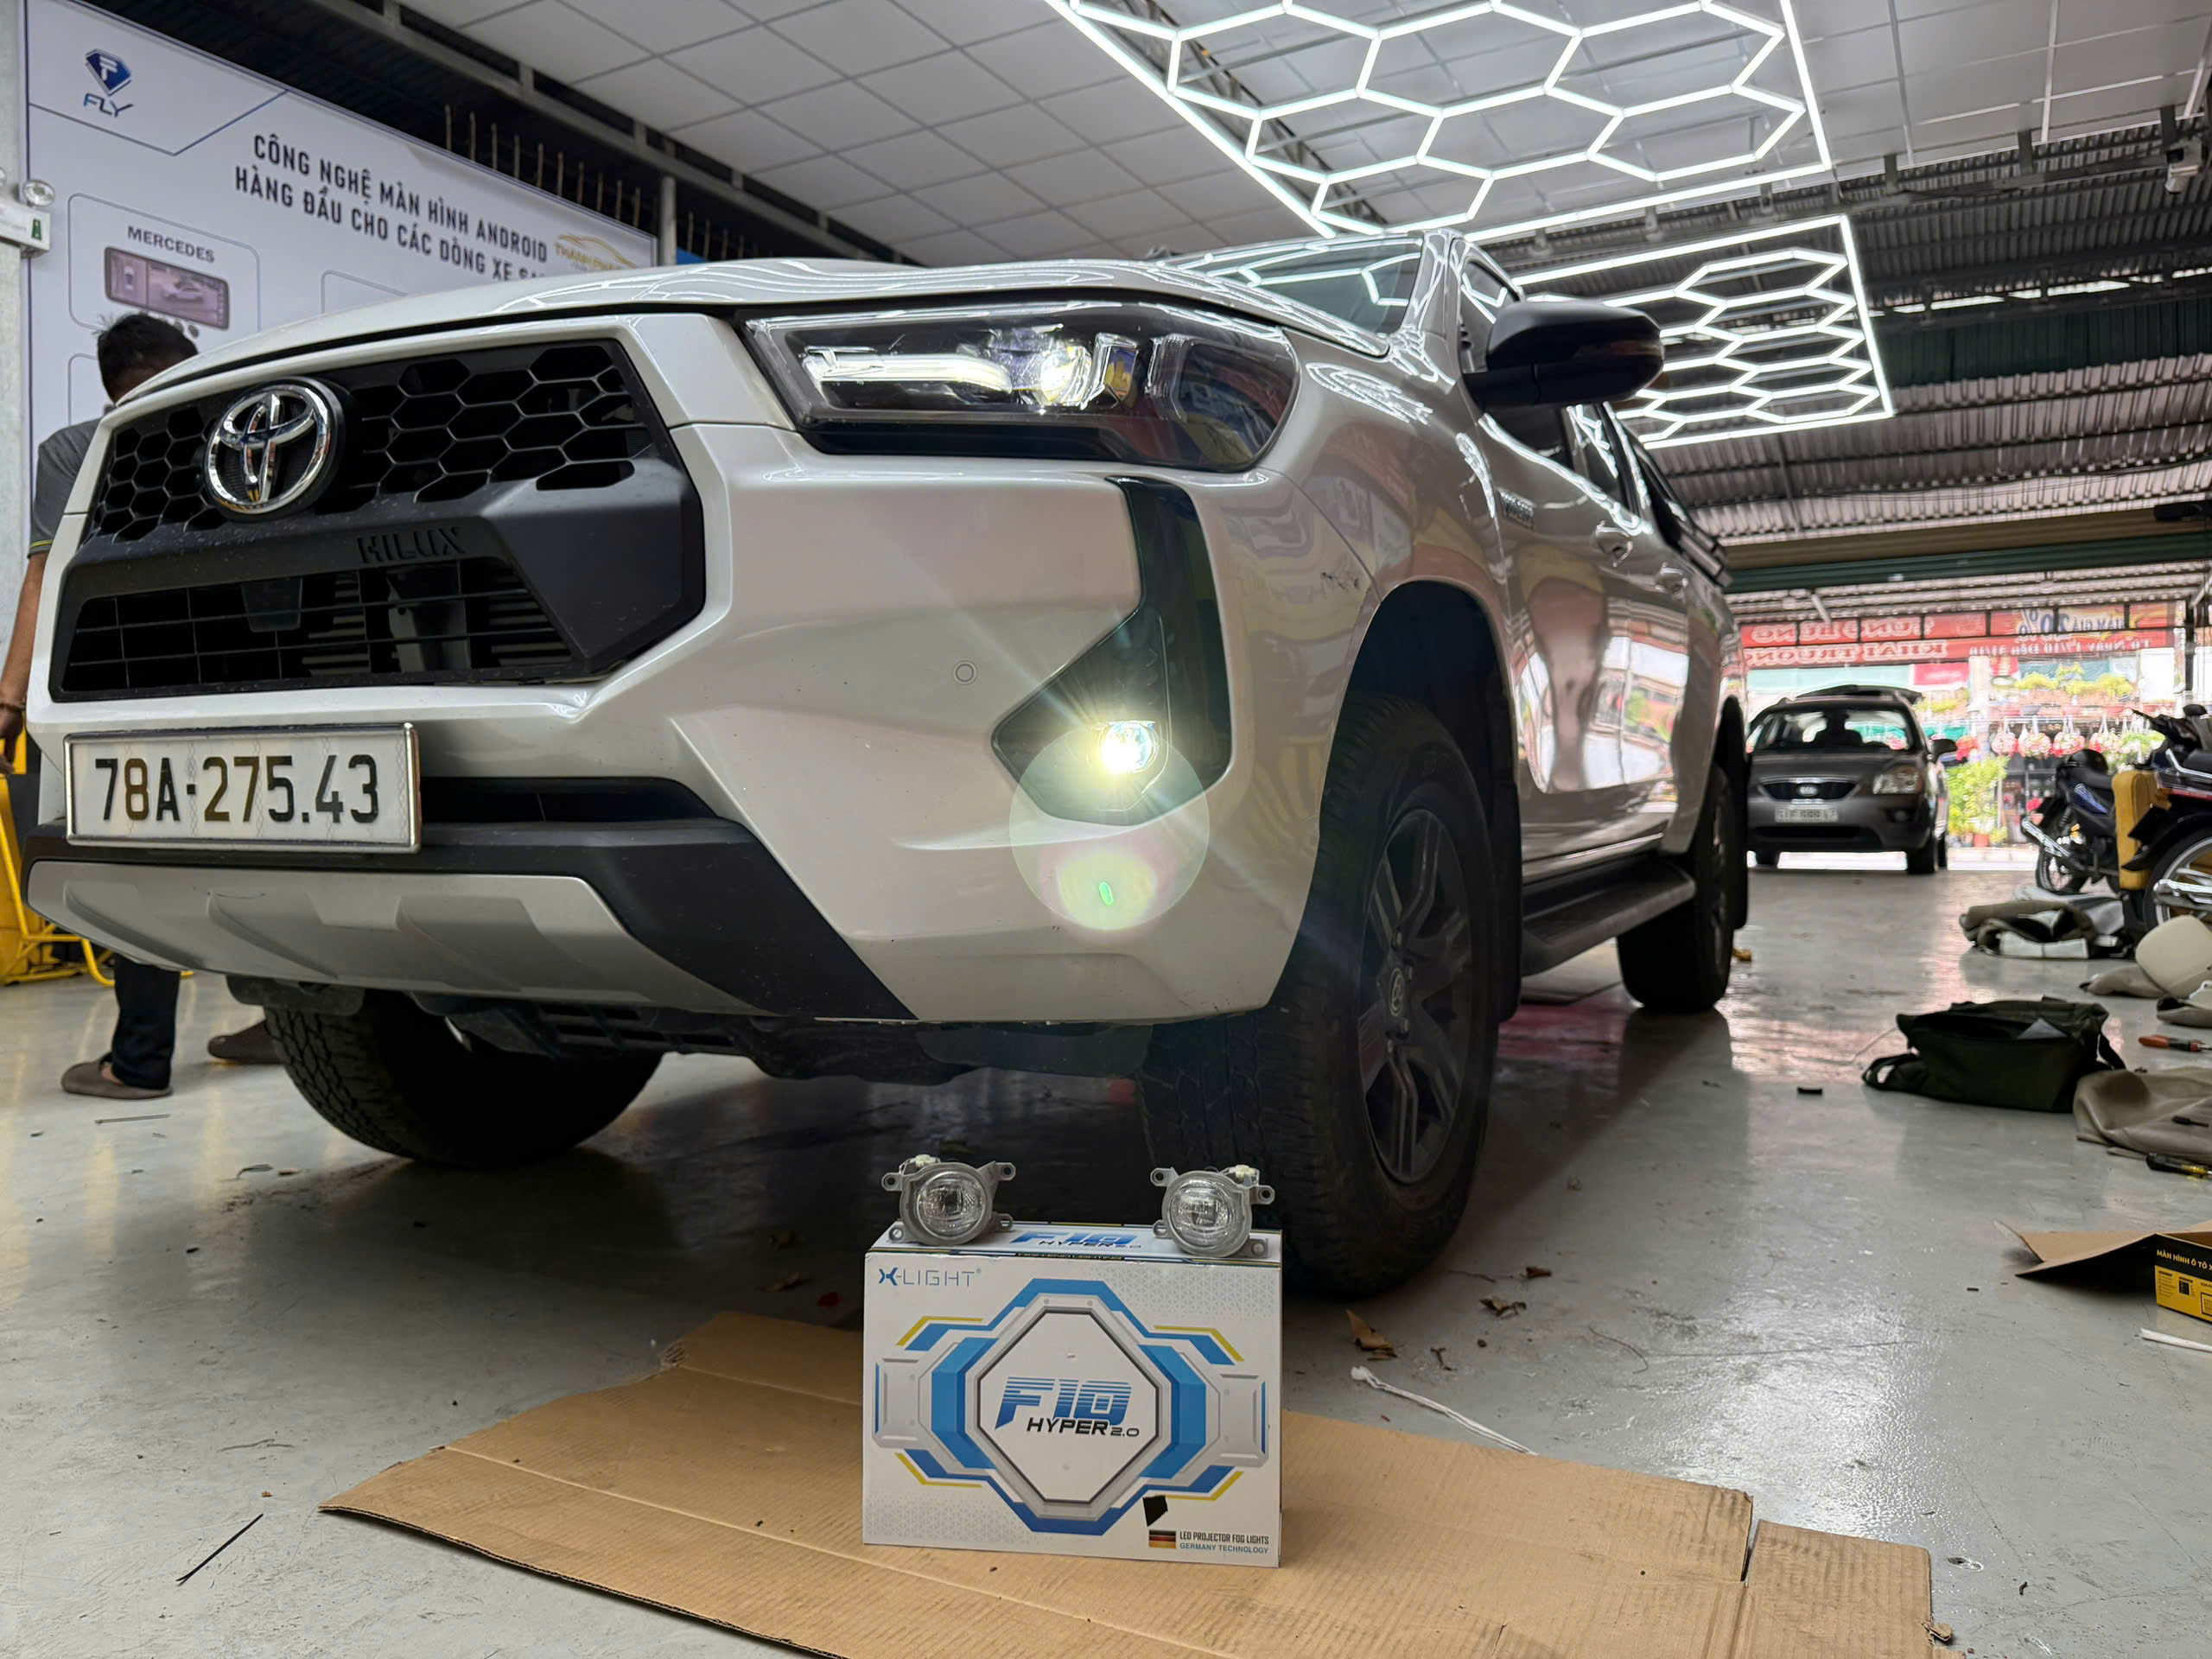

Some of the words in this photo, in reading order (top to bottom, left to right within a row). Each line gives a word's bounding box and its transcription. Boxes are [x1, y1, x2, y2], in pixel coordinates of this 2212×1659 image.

[83, 92, 134, 117] FLY
[254, 133, 309, 175] CÔNG
[320, 156, 372, 205] NGHỆ
[379, 181, 420, 216] MÀN
[428, 195, 469, 235] HÌNH
[476, 219, 548, 263] ANDROID
[235, 164, 293, 207] HÀNG
[303, 185, 341, 224] ĐẦU
[352, 208, 387, 240] CHO
[397, 223, 431, 255] CÁC
[439, 236, 485, 274] DÒNG
[493, 256, 512, 281] XE
[128, 226, 215, 263] MERCEDES
[357, 525, 465, 564] HILUX
[94, 753, 379, 823] 78A-275.43
[1027, 1416, 1110, 1436] HYPER
[1109, 1426, 1140, 1437] 2.0
[1179, 1530, 1192, 1540] LED
[1192, 1531, 1230, 1542] PROJECTOR
[1232, 1534, 1244, 1543] FOG
[1246, 1535, 1269, 1545] LIGHTS
[1179, 1542, 1216, 1552] GERMANY
[1218, 1544, 1268, 1554] TECHNOLOGY
